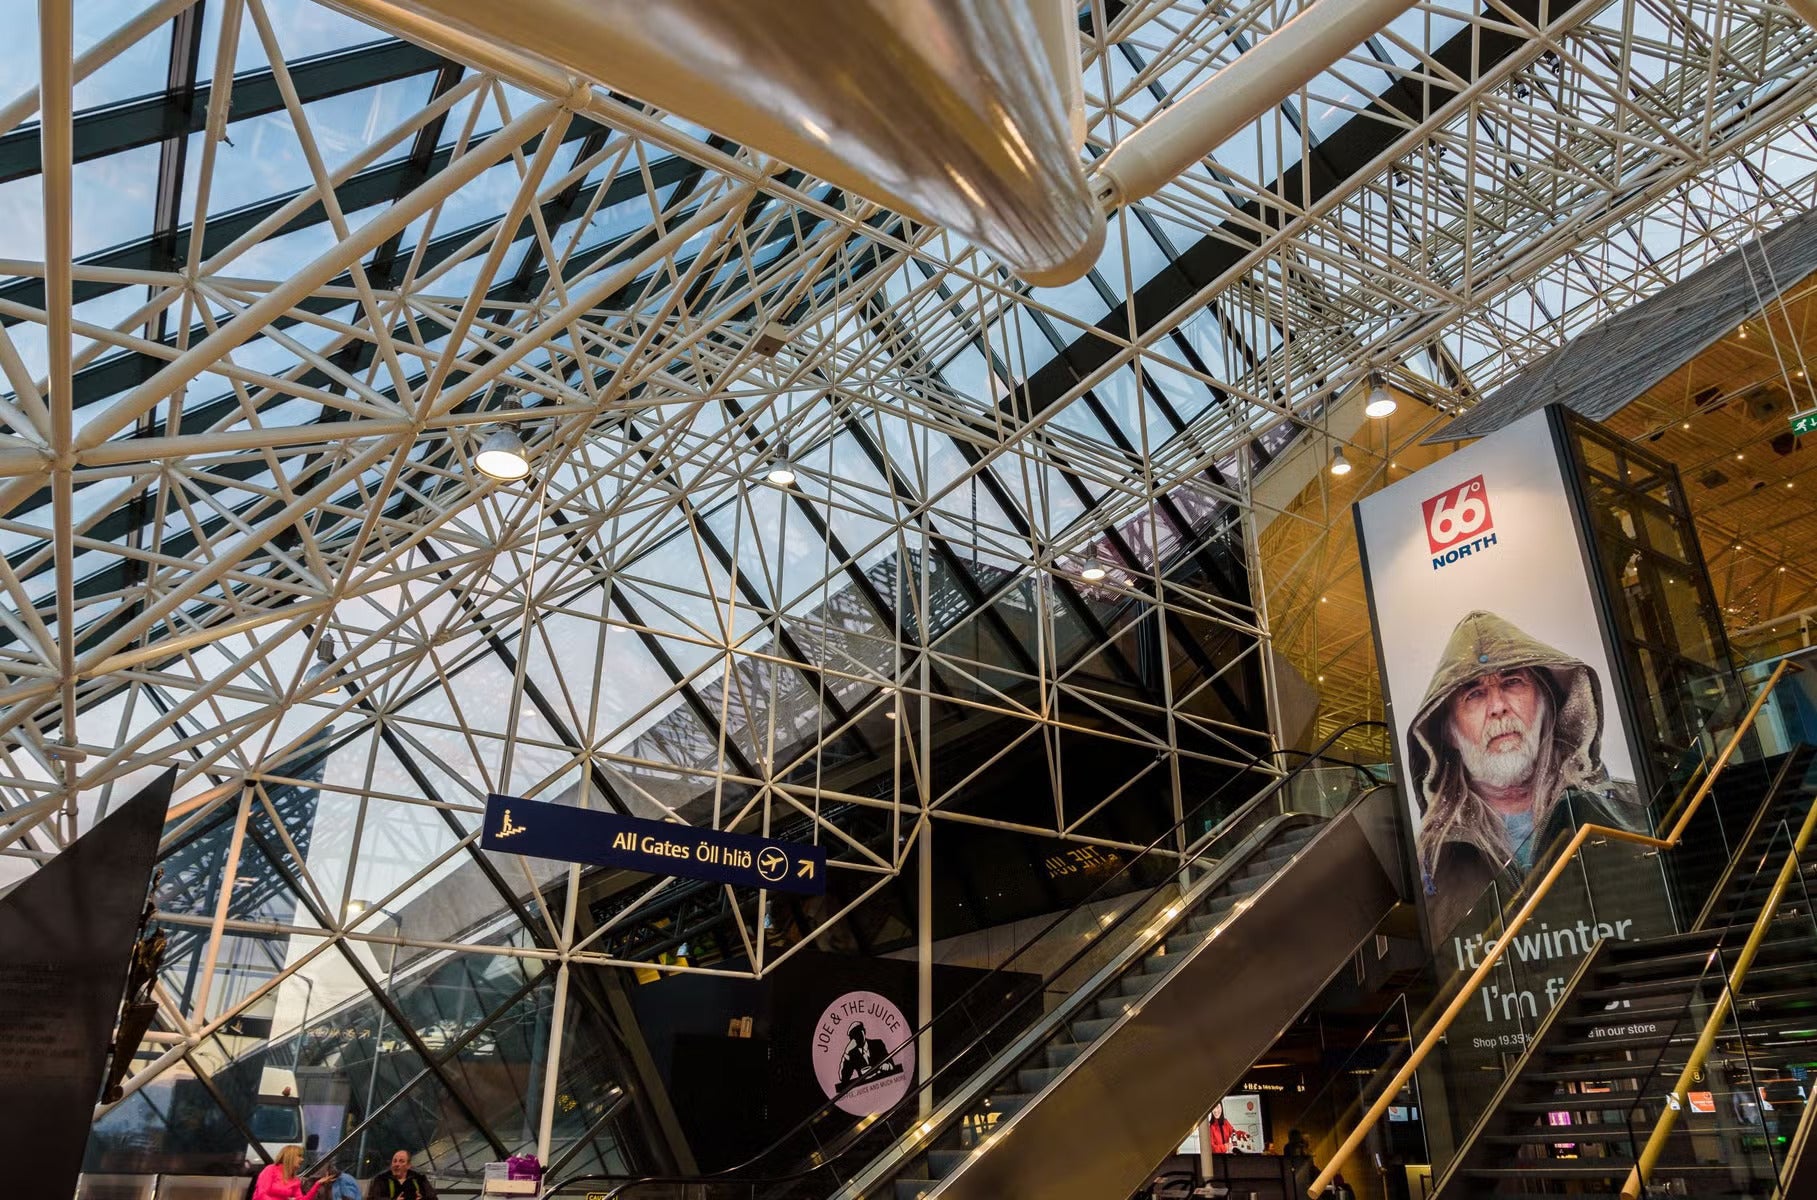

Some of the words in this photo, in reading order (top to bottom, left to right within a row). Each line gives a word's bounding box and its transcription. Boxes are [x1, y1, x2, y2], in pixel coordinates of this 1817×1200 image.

[1432, 533, 1497, 570] NORTH
[612, 832, 637, 851] All
[641, 837, 690, 859] Gates
[696, 841, 719, 864] Öll
[723, 847, 752, 869] hlið
[1482, 985, 1538, 1022] I'm
[817, 1024, 835, 1053] JOE
[830, 1012, 842, 1026] &
[840, 1000, 865, 1016] THE
[868, 1003, 901, 1033] JUICE
[1473, 1037, 1497, 1049] Shop
[1595, 1027, 1606, 1038] in
[1607, 1026, 1626, 1037] our
[1627, 1023, 1657, 1035] store
